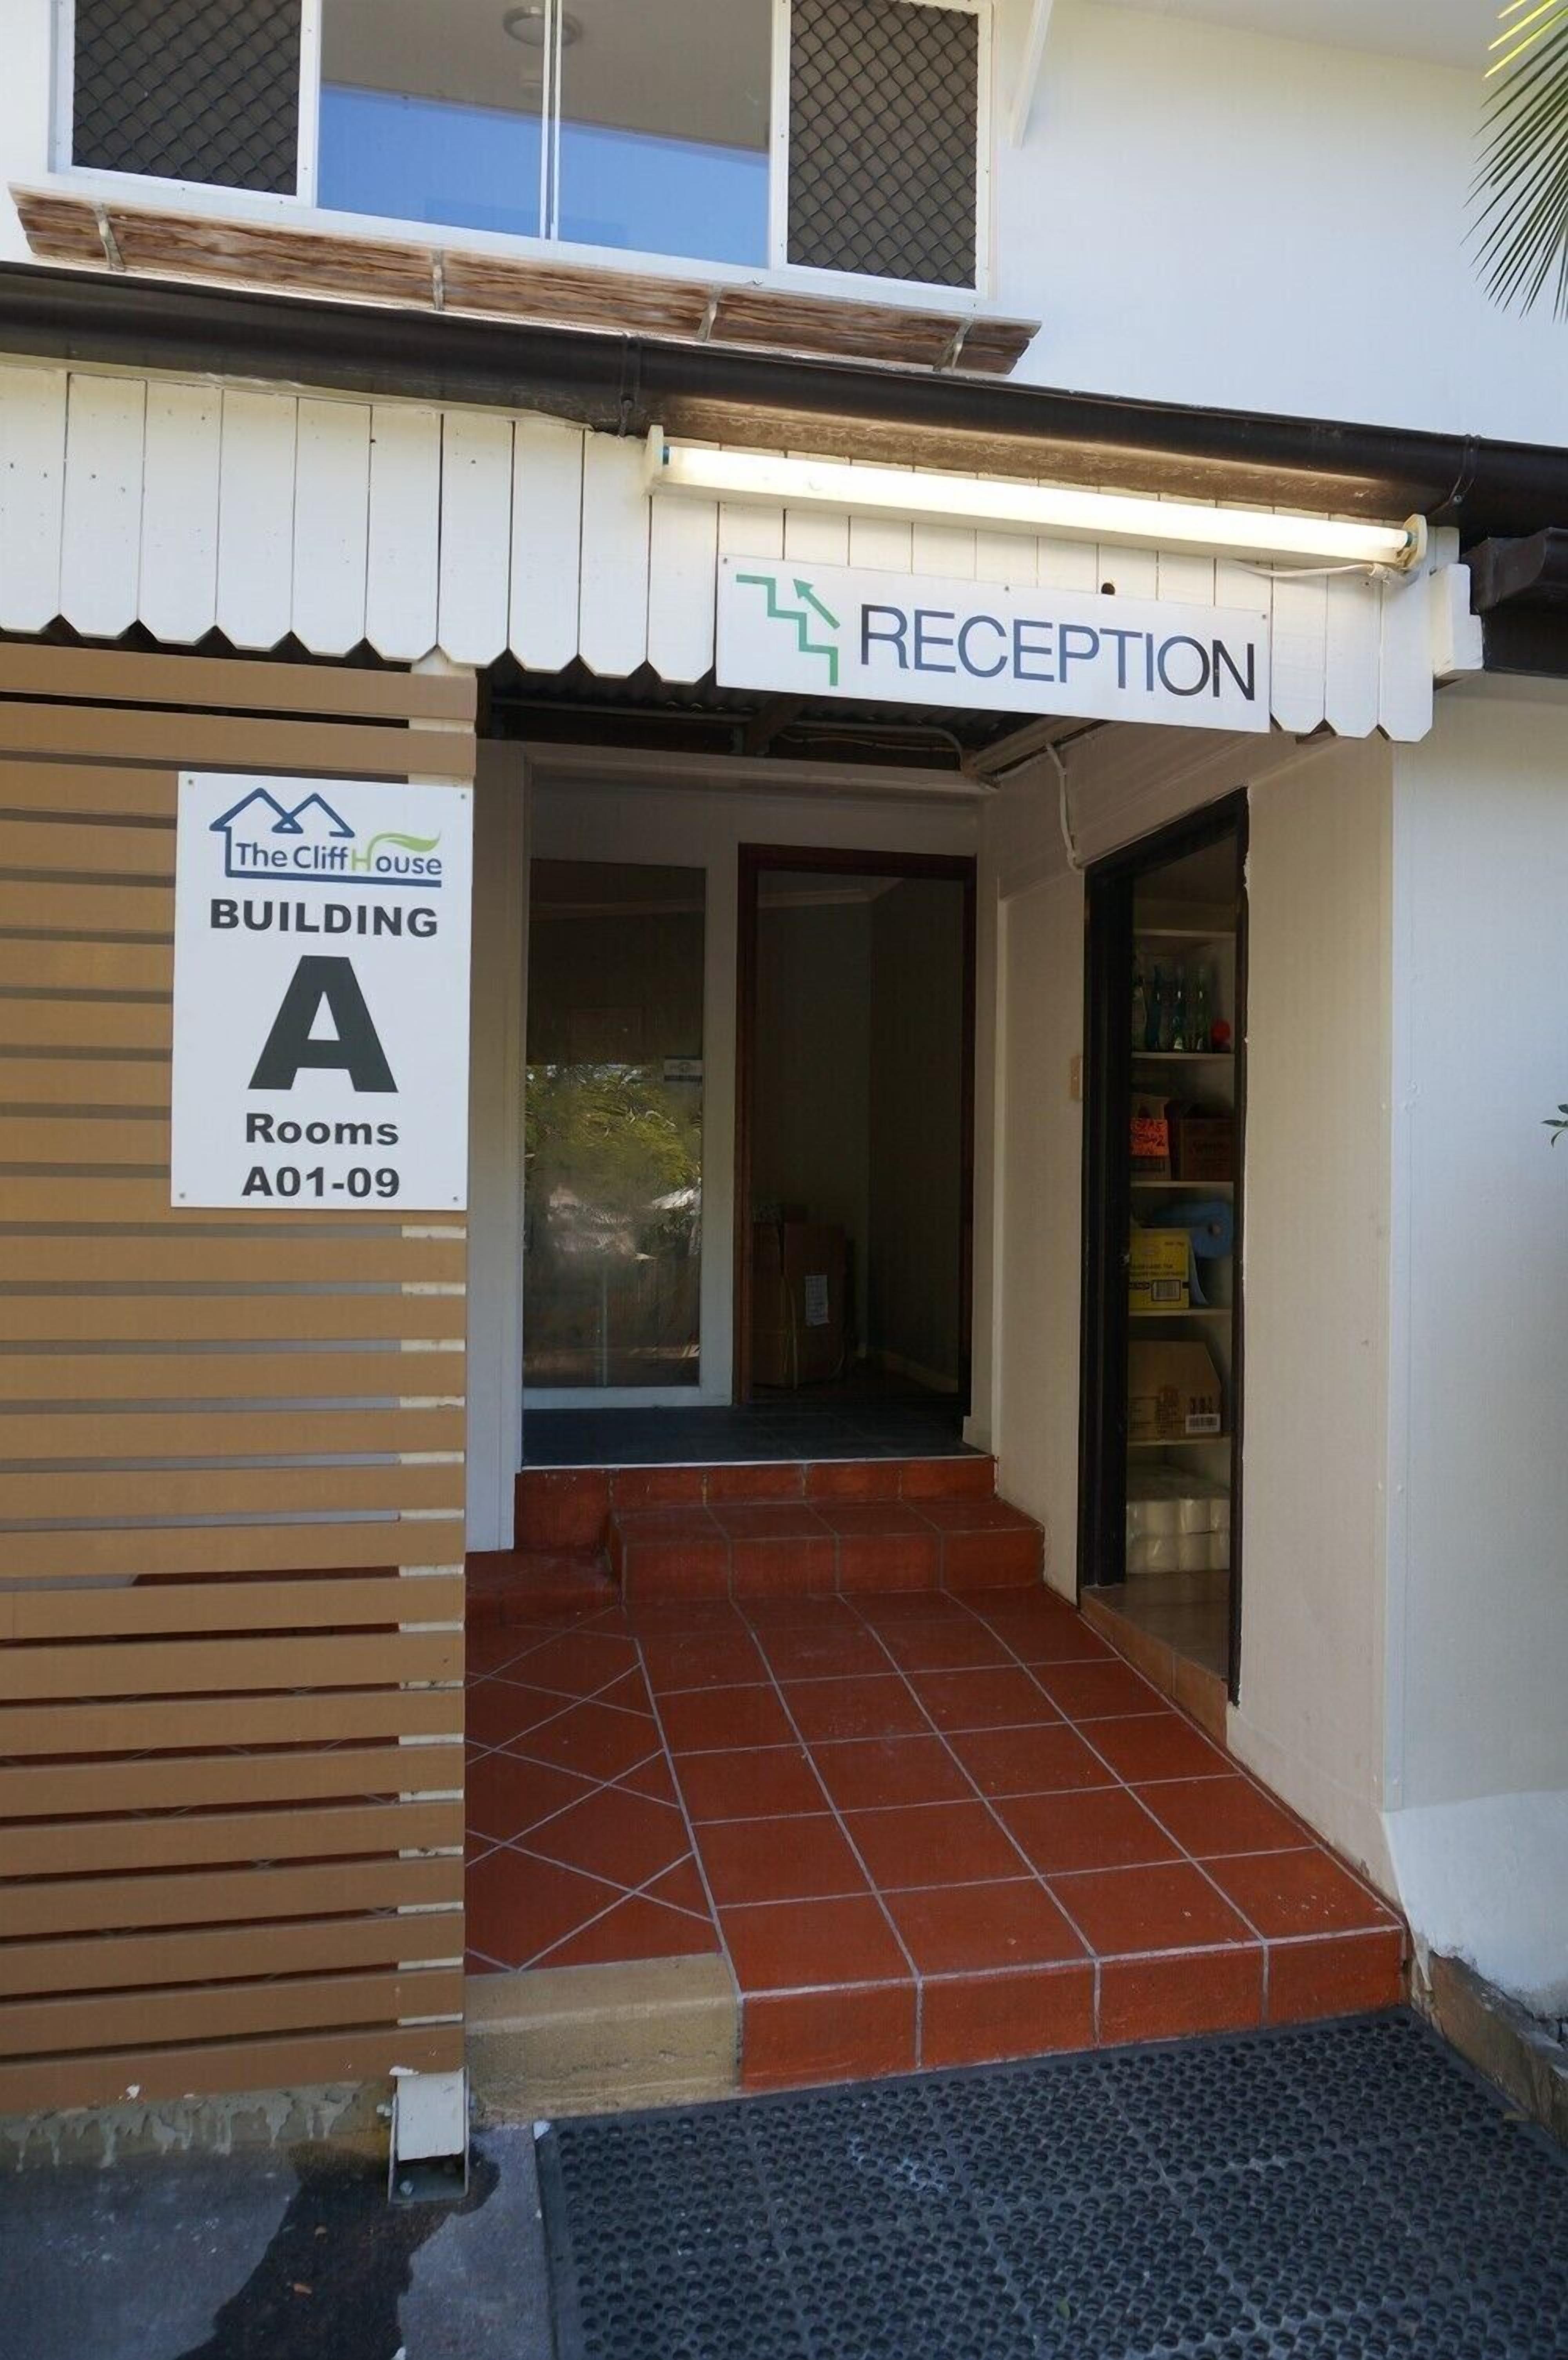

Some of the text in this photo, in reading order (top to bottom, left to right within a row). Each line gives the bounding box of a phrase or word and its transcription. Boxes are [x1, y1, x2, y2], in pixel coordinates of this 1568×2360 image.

[860, 603, 1255, 701] RECEPTION
[235, 842, 288, 868] The
[210, 898, 437, 938] BUILDING
[247, 955, 399, 1093] A
[246, 1112, 399, 1146] Rooms
[241, 1166, 400, 1198] A01-09
